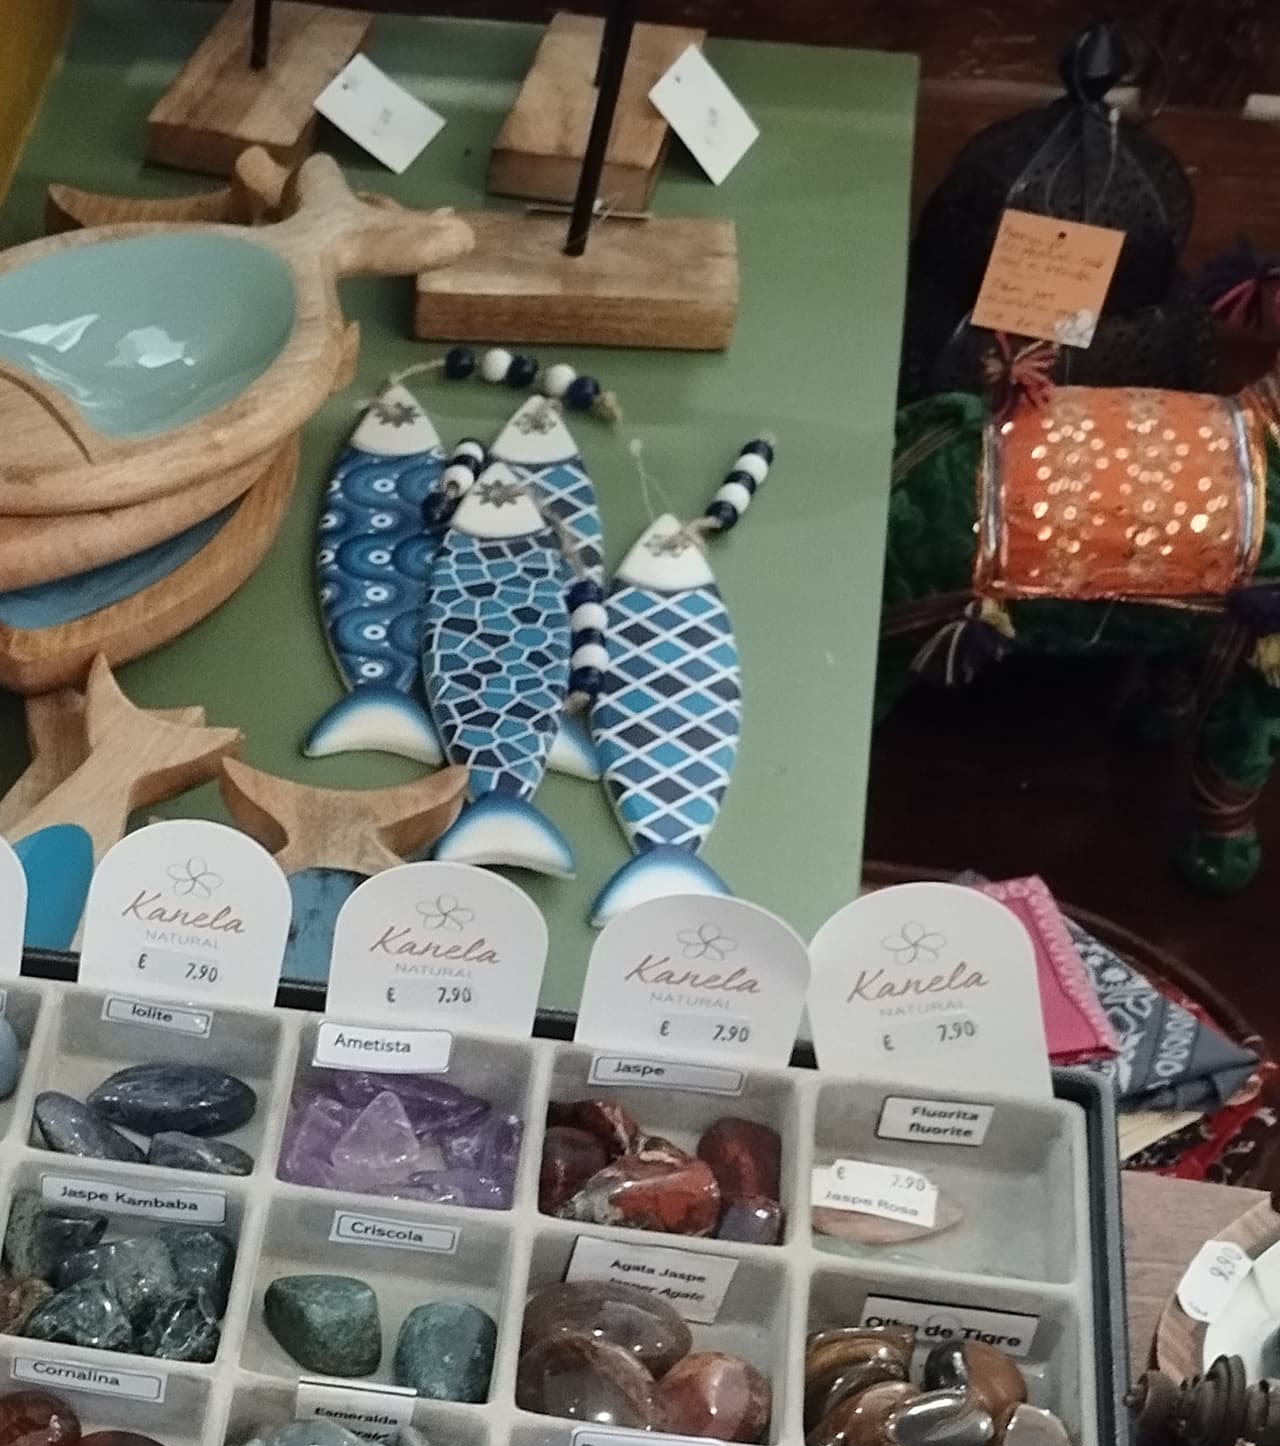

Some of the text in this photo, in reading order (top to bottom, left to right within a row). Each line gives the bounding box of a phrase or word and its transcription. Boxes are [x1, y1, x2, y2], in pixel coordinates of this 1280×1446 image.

[122, 890, 244, 933] Kanela
[369, 925, 498, 965] Kanela
[624, 953, 761, 994] Kanela
[847, 961, 989, 1004] Kanela
[334, 1033, 411, 1053] Ametista
[613, 1060, 665, 1077] Jaspe
[911, 1105, 980, 1122] Fluorita
[60, 1186, 199, 1212] Jaspe Kambaba
[877, 1200, 920, 1218] Rosa
[351, 1221, 424, 1243] Criscola
[659, 1269, 706, 1283] Jaspe
[925, 1325, 953, 1339] de
[32, 1361, 120, 1387] Cornalina
